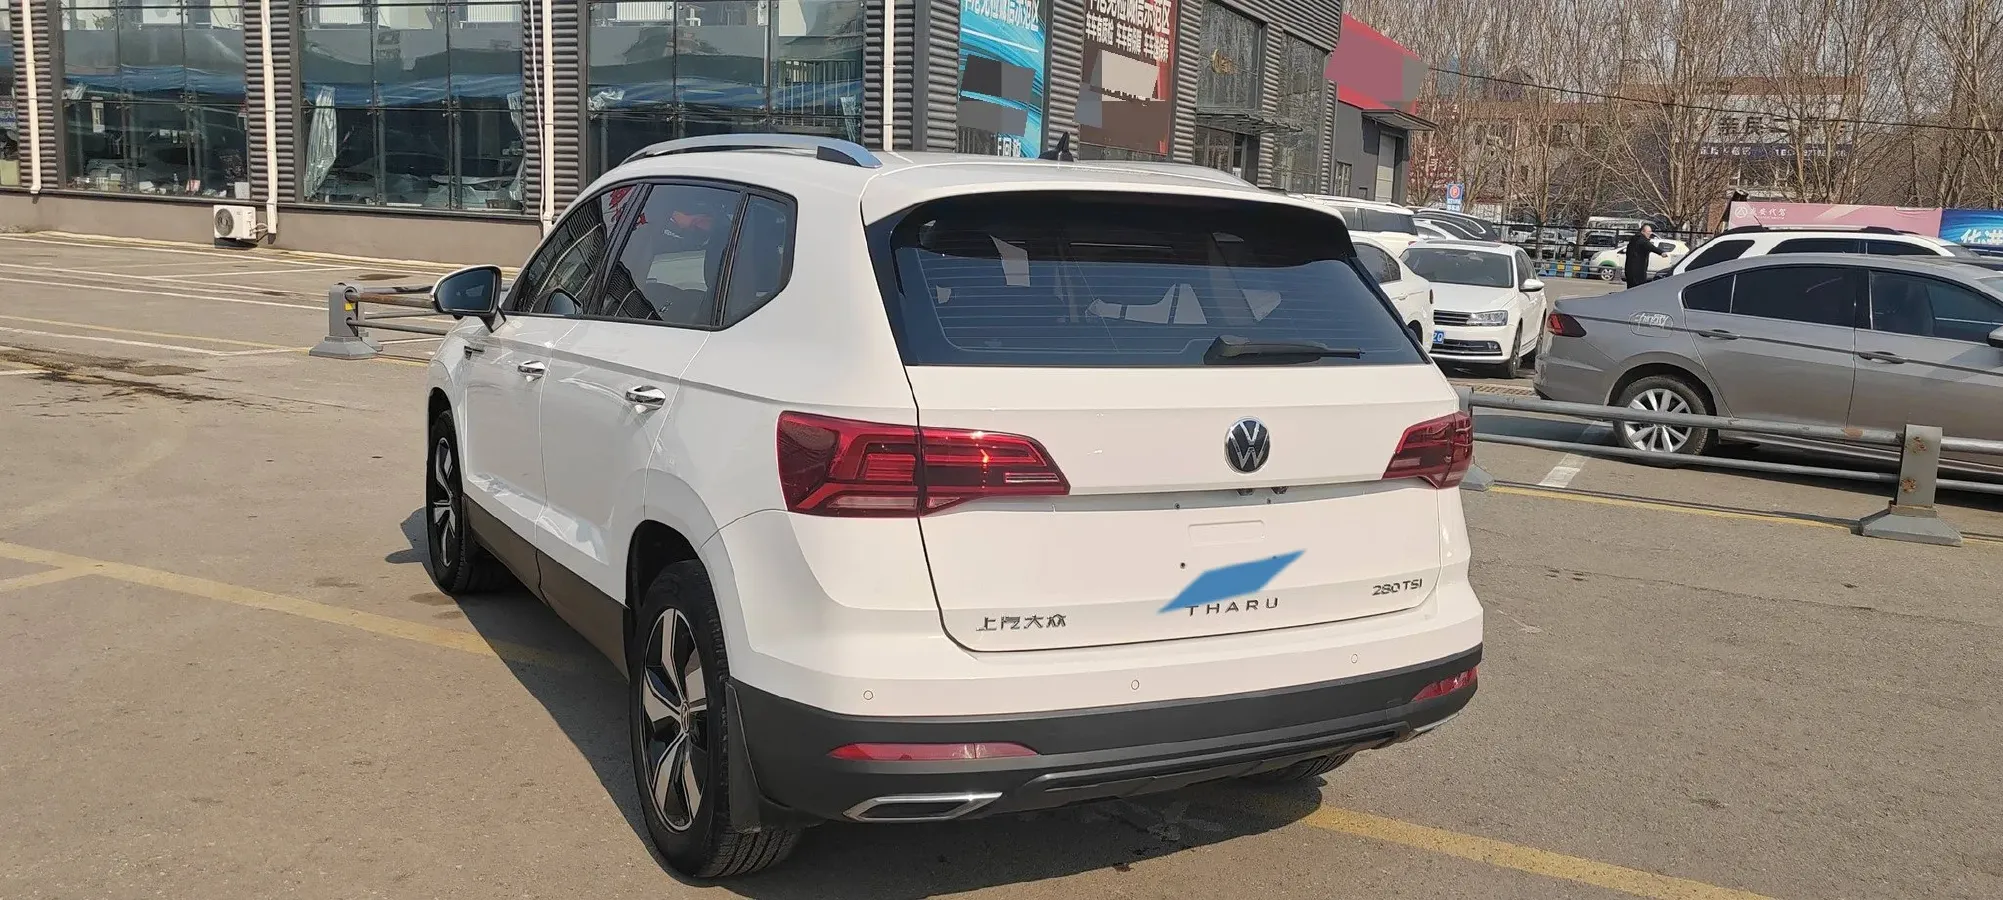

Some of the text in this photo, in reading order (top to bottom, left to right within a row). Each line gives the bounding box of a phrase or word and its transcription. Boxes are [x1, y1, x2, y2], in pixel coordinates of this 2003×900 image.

[1185, 597, 1279, 617] THARU
[976, 613, 1067, 631] 上汽大众
